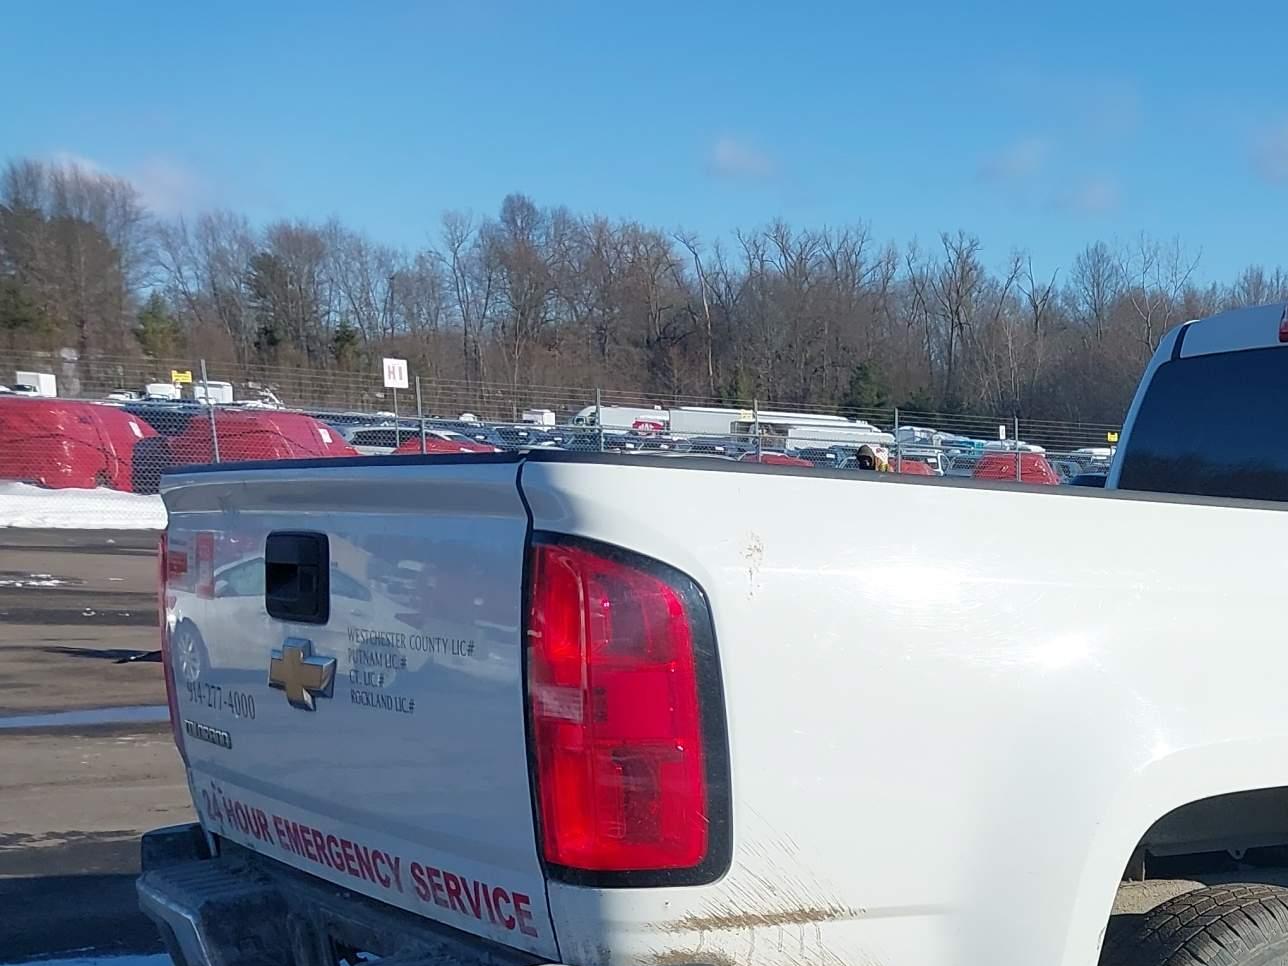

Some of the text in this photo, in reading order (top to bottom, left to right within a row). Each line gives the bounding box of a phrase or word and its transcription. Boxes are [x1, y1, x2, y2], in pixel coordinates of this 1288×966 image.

[347, 626, 407, 649] WESTCHESTER
[409, 634, 449, 655] COUNTY
[348, 647, 383, 668] PUTNAM
[186, 680, 256, 720] 914-277-4000
[351, 688, 393, 711] ROCKLAND
[201, 788, 539, 938] 24 HOUR EMERGENCY SERVICE
